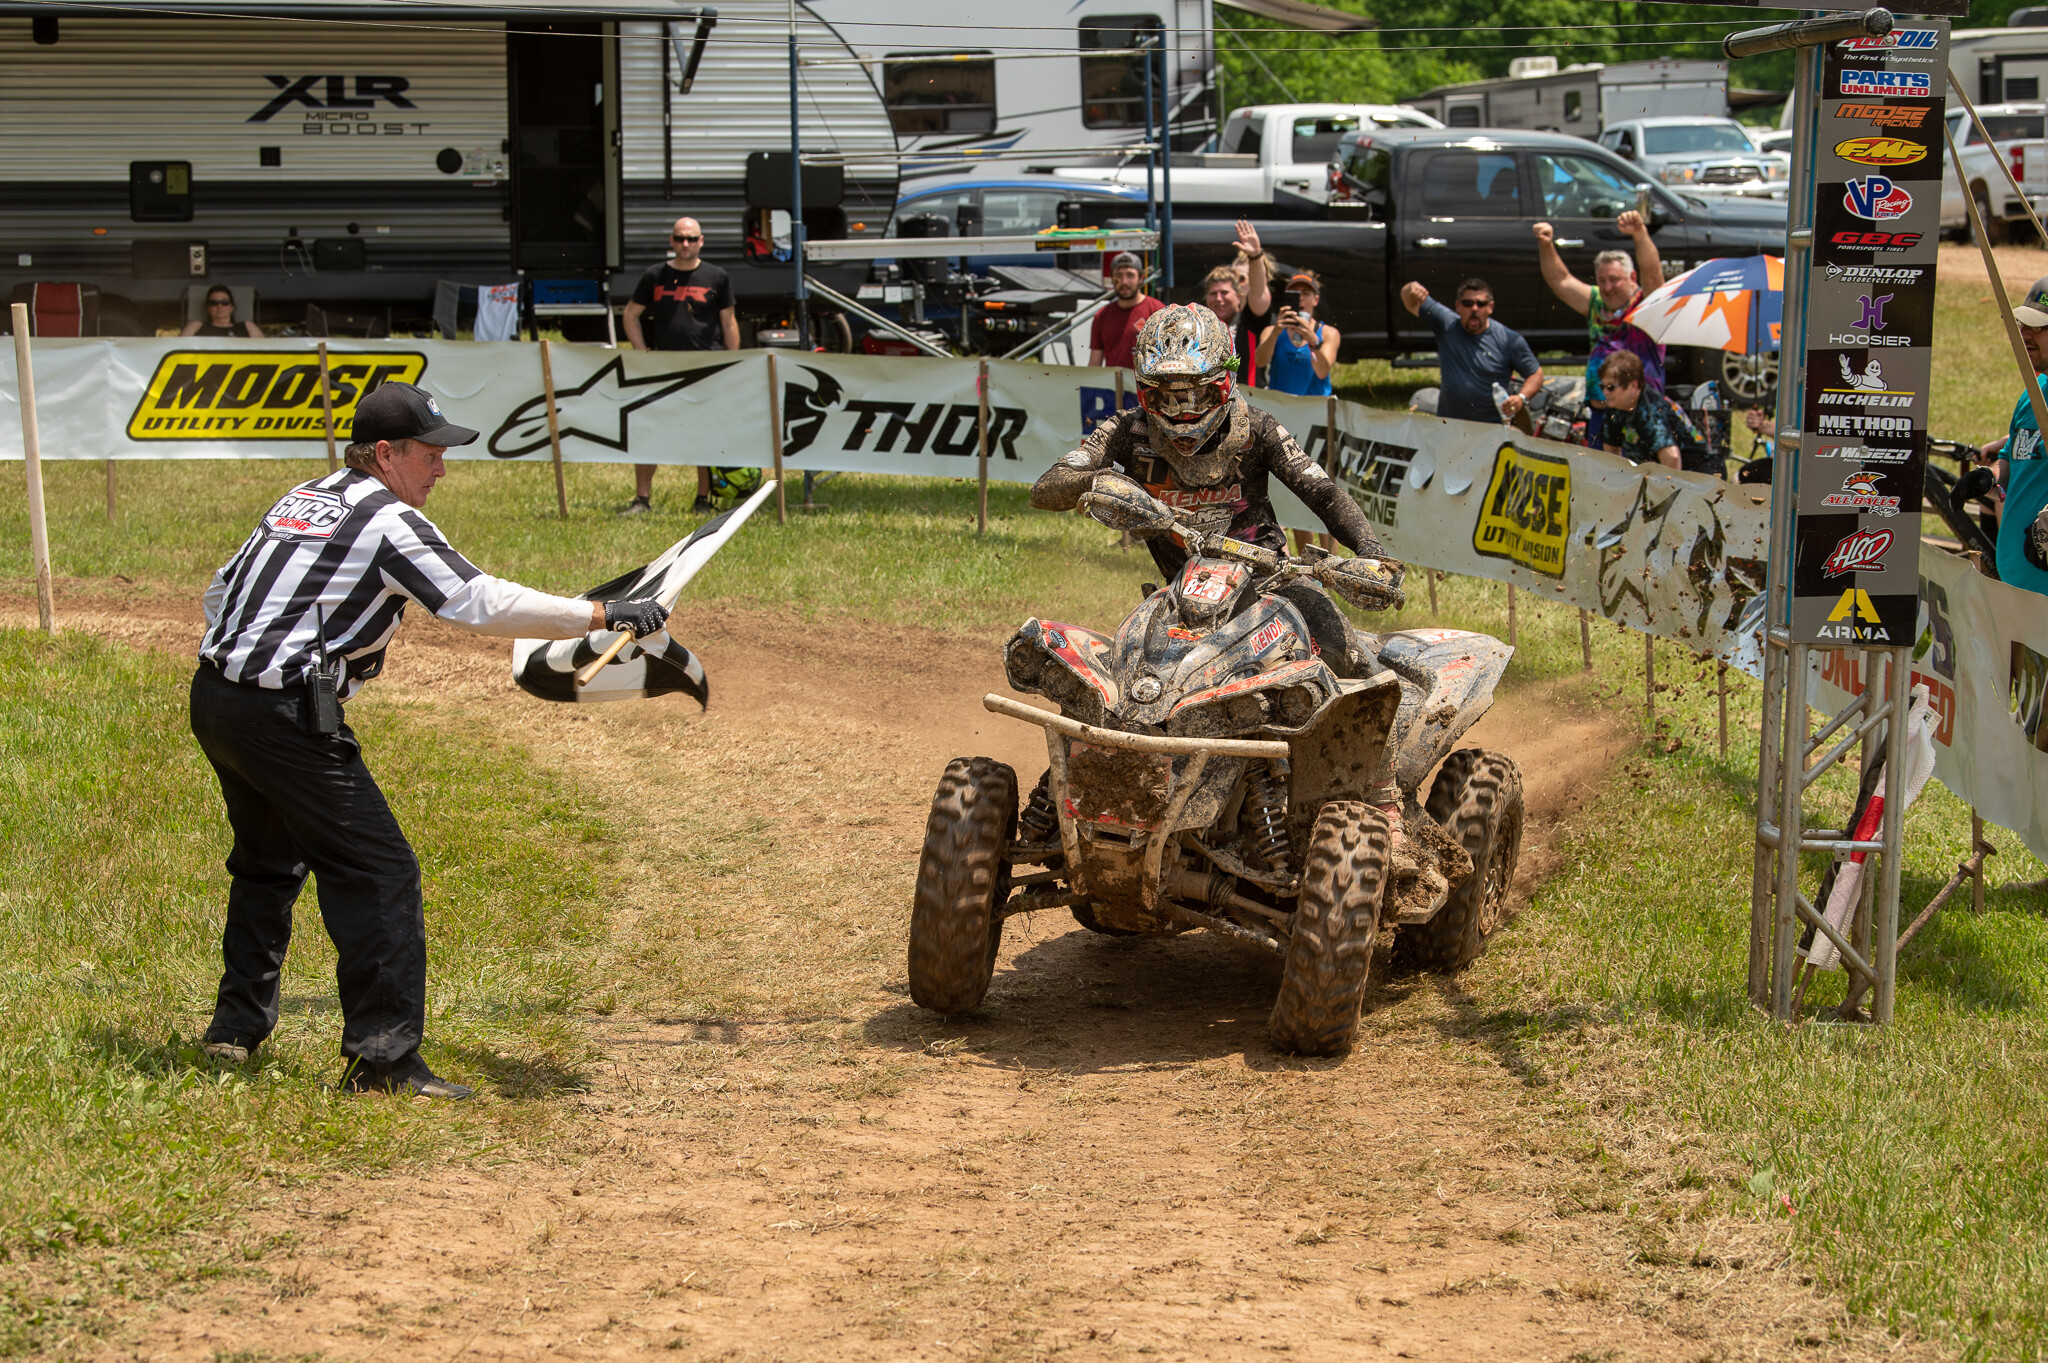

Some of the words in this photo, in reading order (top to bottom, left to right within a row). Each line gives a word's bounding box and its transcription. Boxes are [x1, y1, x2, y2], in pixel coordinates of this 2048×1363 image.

[1841, 70, 1930, 87] PARTS
[1841, 84, 1929, 96] UNLIMITED
[245, 75, 418, 122] XLR
[305, 112, 370, 121] MICRO
[1835, 104, 1932, 120] MOOSE
[302, 123, 430, 135] BOOST
[1872, 119, 1921, 128] RACING
[1836, 141, 1928, 160] FMF
[1845, 175, 1893, 218] VP
[1876, 198, 1913, 212] Racing
[1831, 232, 1922, 246] GBC
[1840, 276, 1890, 284] MOTORCYCLE
[1844, 267, 1923, 279] DUNLOP
[1829, 334, 1911, 346] HOOSIER
[1818, 393, 1913, 407] MICHELIN
[143, 416, 246, 430] UTILITY
[253, 417, 353, 431] DIVISIO
[841, 399, 1028, 461] THOR
[1819, 415, 1912, 431] METHOD
[1857, 430, 1911, 438] WHEELS
[1840, 447, 1912, 461] WISECO
[1158, 483, 1243, 507] KENDA
[1822, 495, 1850, 506] ALL
[1852, 496, 1900, 507] BALLS
[268, 496, 344, 527] GNCC
[1869, 505, 1900, 517] Racing
[273, 517, 311, 531] RACING
[1831, 530, 1893, 569] HBD
[1250, 617, 1286, 657] KENDA
[1816, 625, 1890, 641] ARMA
